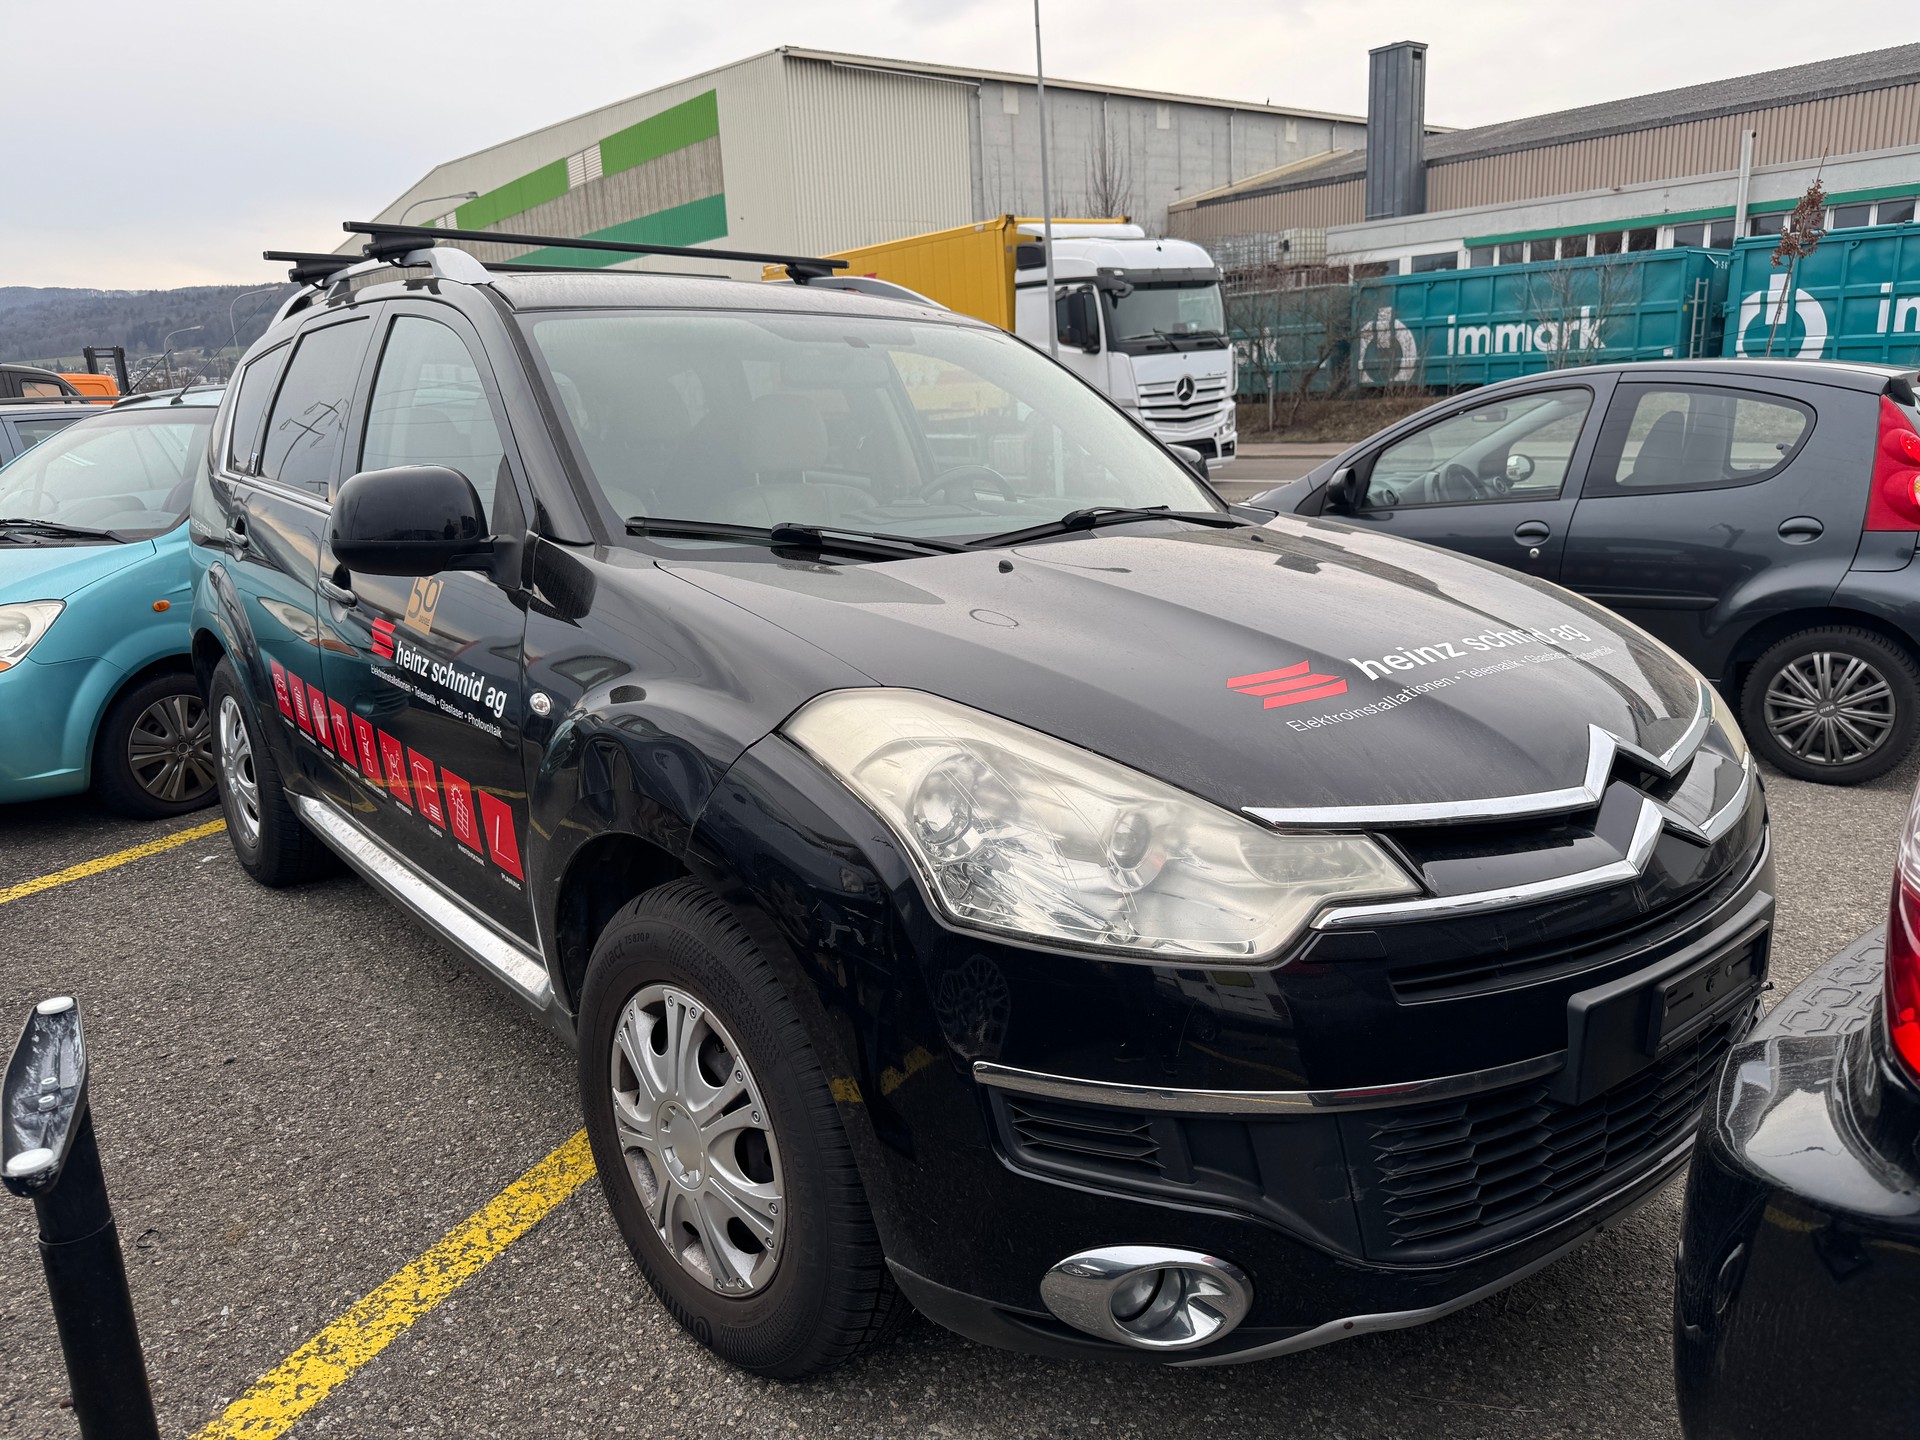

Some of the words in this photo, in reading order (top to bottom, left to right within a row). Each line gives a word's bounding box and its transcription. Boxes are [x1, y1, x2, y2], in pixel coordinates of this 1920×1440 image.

[1447, 306, 1607, 356] immark
[408, 576, 440, 619] 50
[395, 640, 430, 678] heinz
[431, 662, 485, 702] schmid
[485, 686, 507, 718] ag
[1349, 641, 1468, 680] heinz
[1461, 627, 1560, 651] schmid
[1549, 623, 1592, 642] ag
[370, 663, 412, 693] Elektroinstallationen
[414, 685, 437, 706] Telematik
[439, 698, 464, 720] Glasfaser
[467, 712, 502, 738] Photovoltaik
[1286, 675, 1457, 732] Elektroinstallationen
[1457, 659, 1525, 680] Telematik
[1523, 652, 1568, 664] Glasfas
